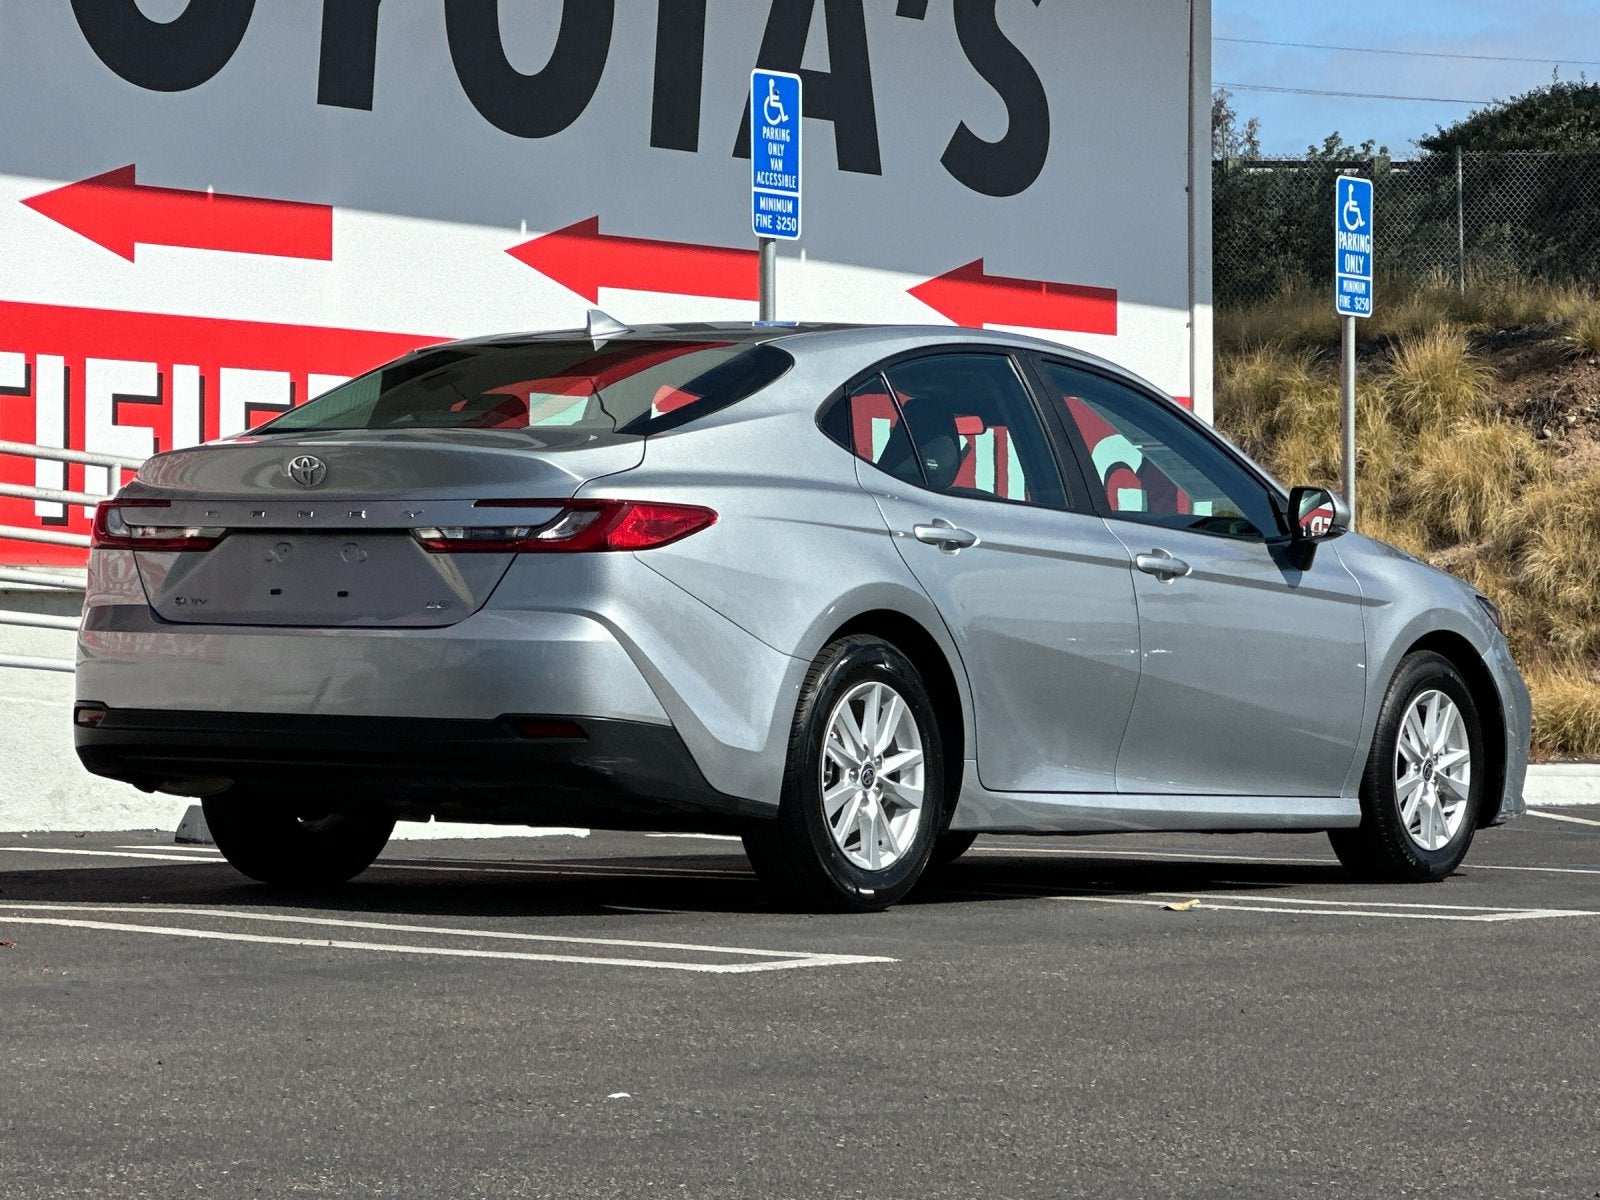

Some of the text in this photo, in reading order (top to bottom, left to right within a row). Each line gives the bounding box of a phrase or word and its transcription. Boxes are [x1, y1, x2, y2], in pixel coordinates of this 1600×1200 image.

[762, 126, 790, 142] PARKING
[768, 143, 784, 156] ONLY
[771, 158, 783, 171] VAN
[756, 171, 796, 188] ACCESSIBLE
[760, 196, 793, 213] MINIMUM
[756, 213, 796, 231] FINE $250
[1338, 231, 1370, 254] PARKING
[1345, 253, 1364, 274] ONLY
[1343, 279, 1365, 294] MINIMUM
[1339, 295, 1369, 311] FINE $250
